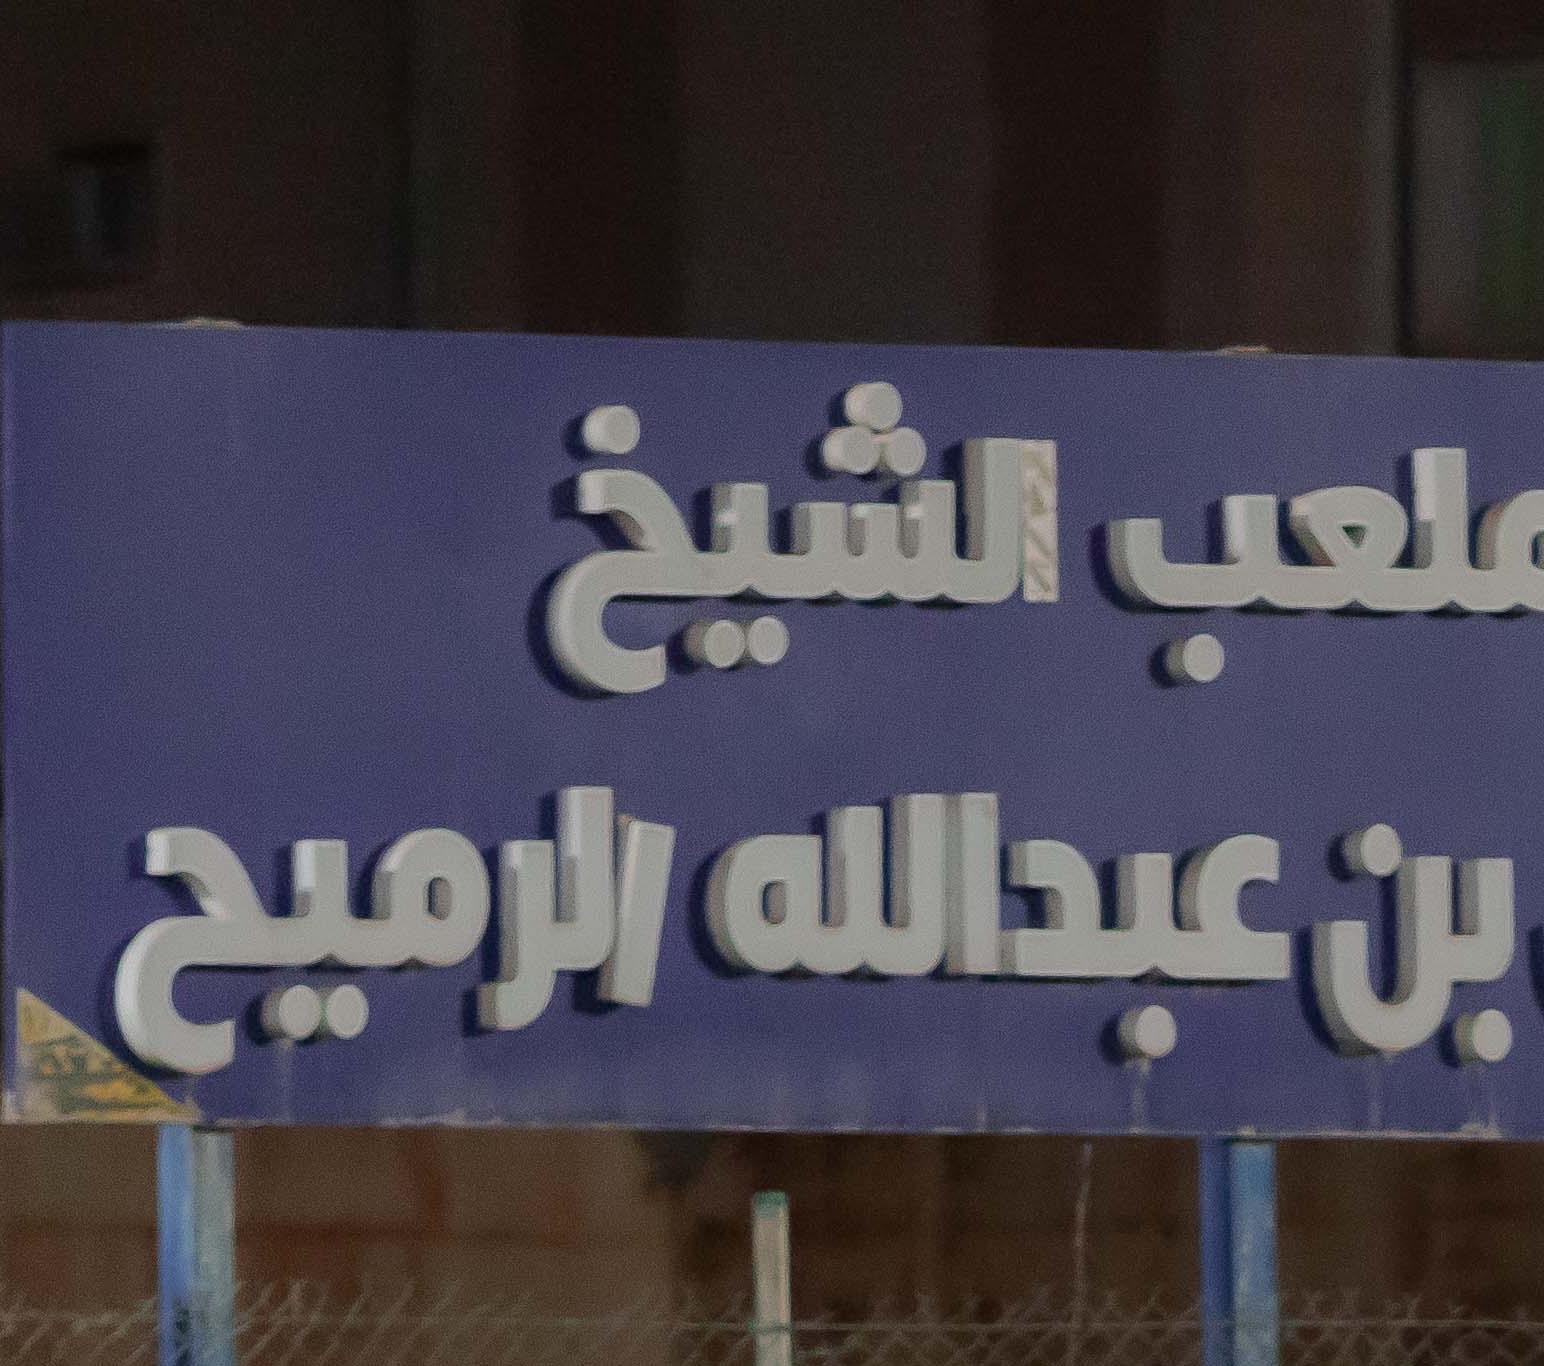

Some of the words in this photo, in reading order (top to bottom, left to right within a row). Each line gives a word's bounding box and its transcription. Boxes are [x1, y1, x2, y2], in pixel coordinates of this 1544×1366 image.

[547, 380, 1059, 694] الشيخ
[113, 785, 677, 1076] الرميح
[705, 791, 1291, 1060] عبدالله
[1313, 823, 1516, 1063] بن
